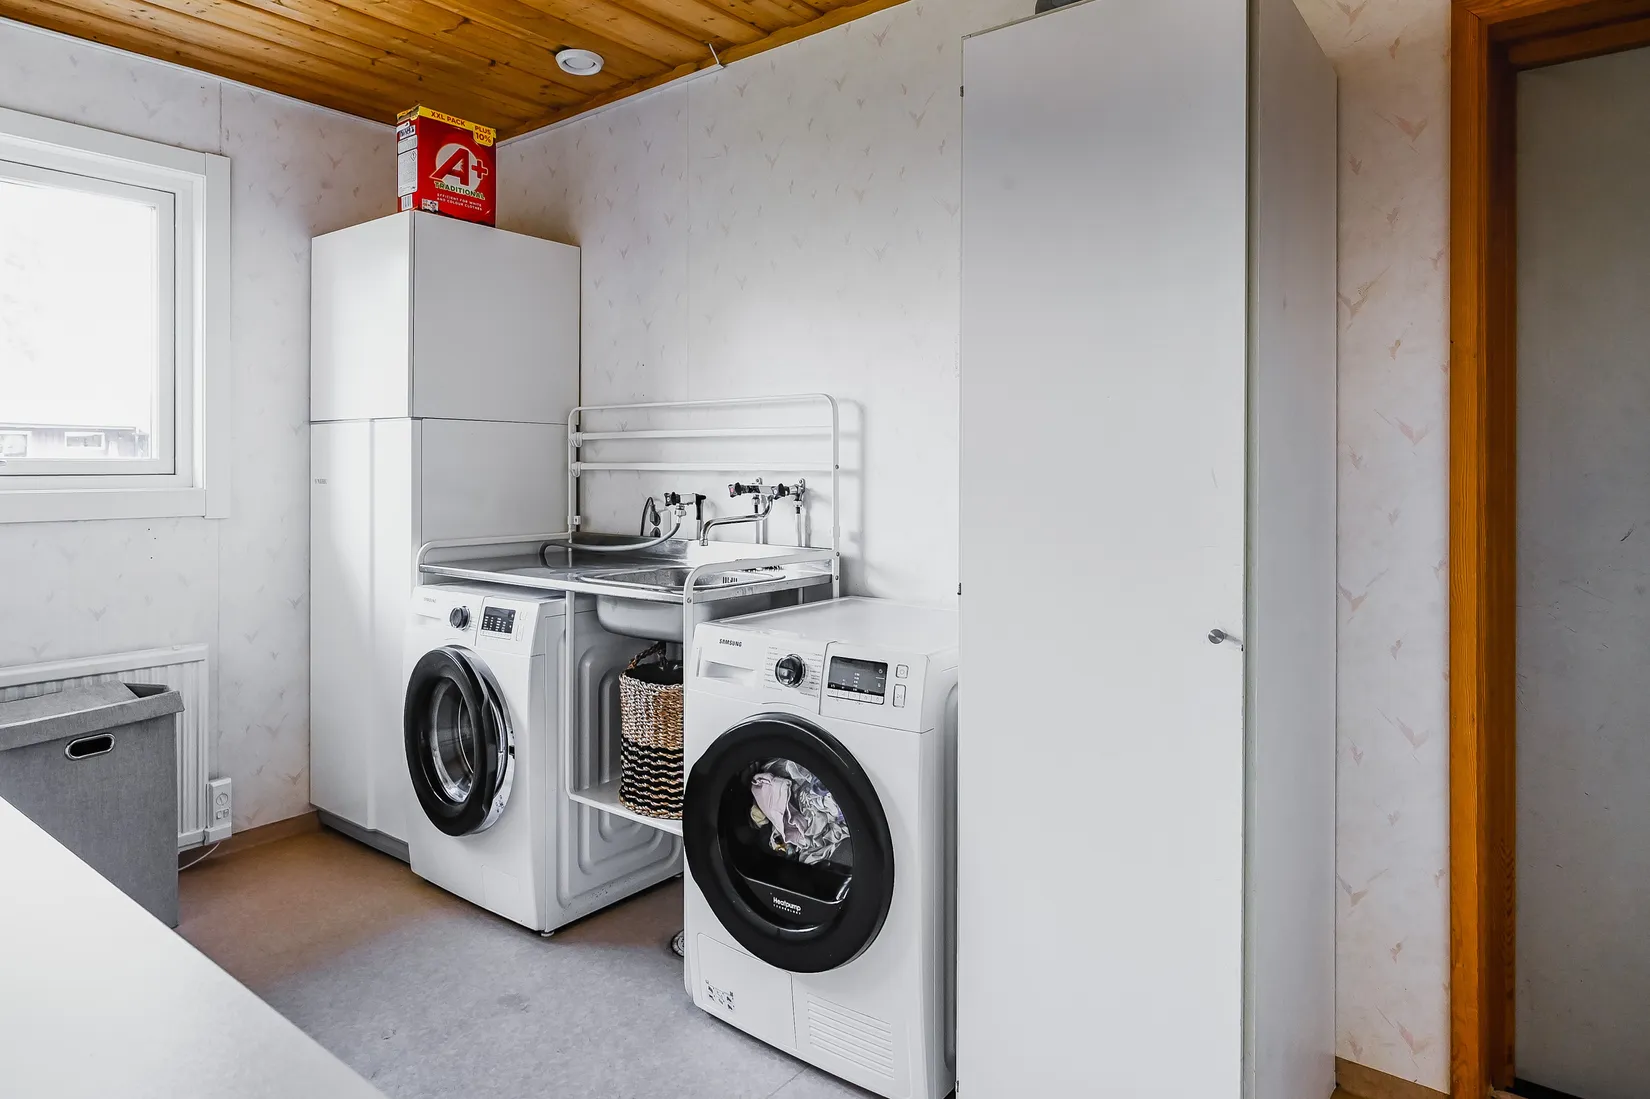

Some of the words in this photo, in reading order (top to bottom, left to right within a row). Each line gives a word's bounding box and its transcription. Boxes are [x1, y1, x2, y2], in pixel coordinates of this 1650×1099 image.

[430, 110, 446, 121] XXL
[446, 115, 466, 127] PACK
[474, 125, 492, 136] PLUS
[475, 131, 492, 144] 10%
[429, 147, 489, 187] A+
[434, 180, 486, 201] TRADITIONAL
[719, 638, 742, 648] SAMSUNG
[772, 896, 802, 912] Heatpump
